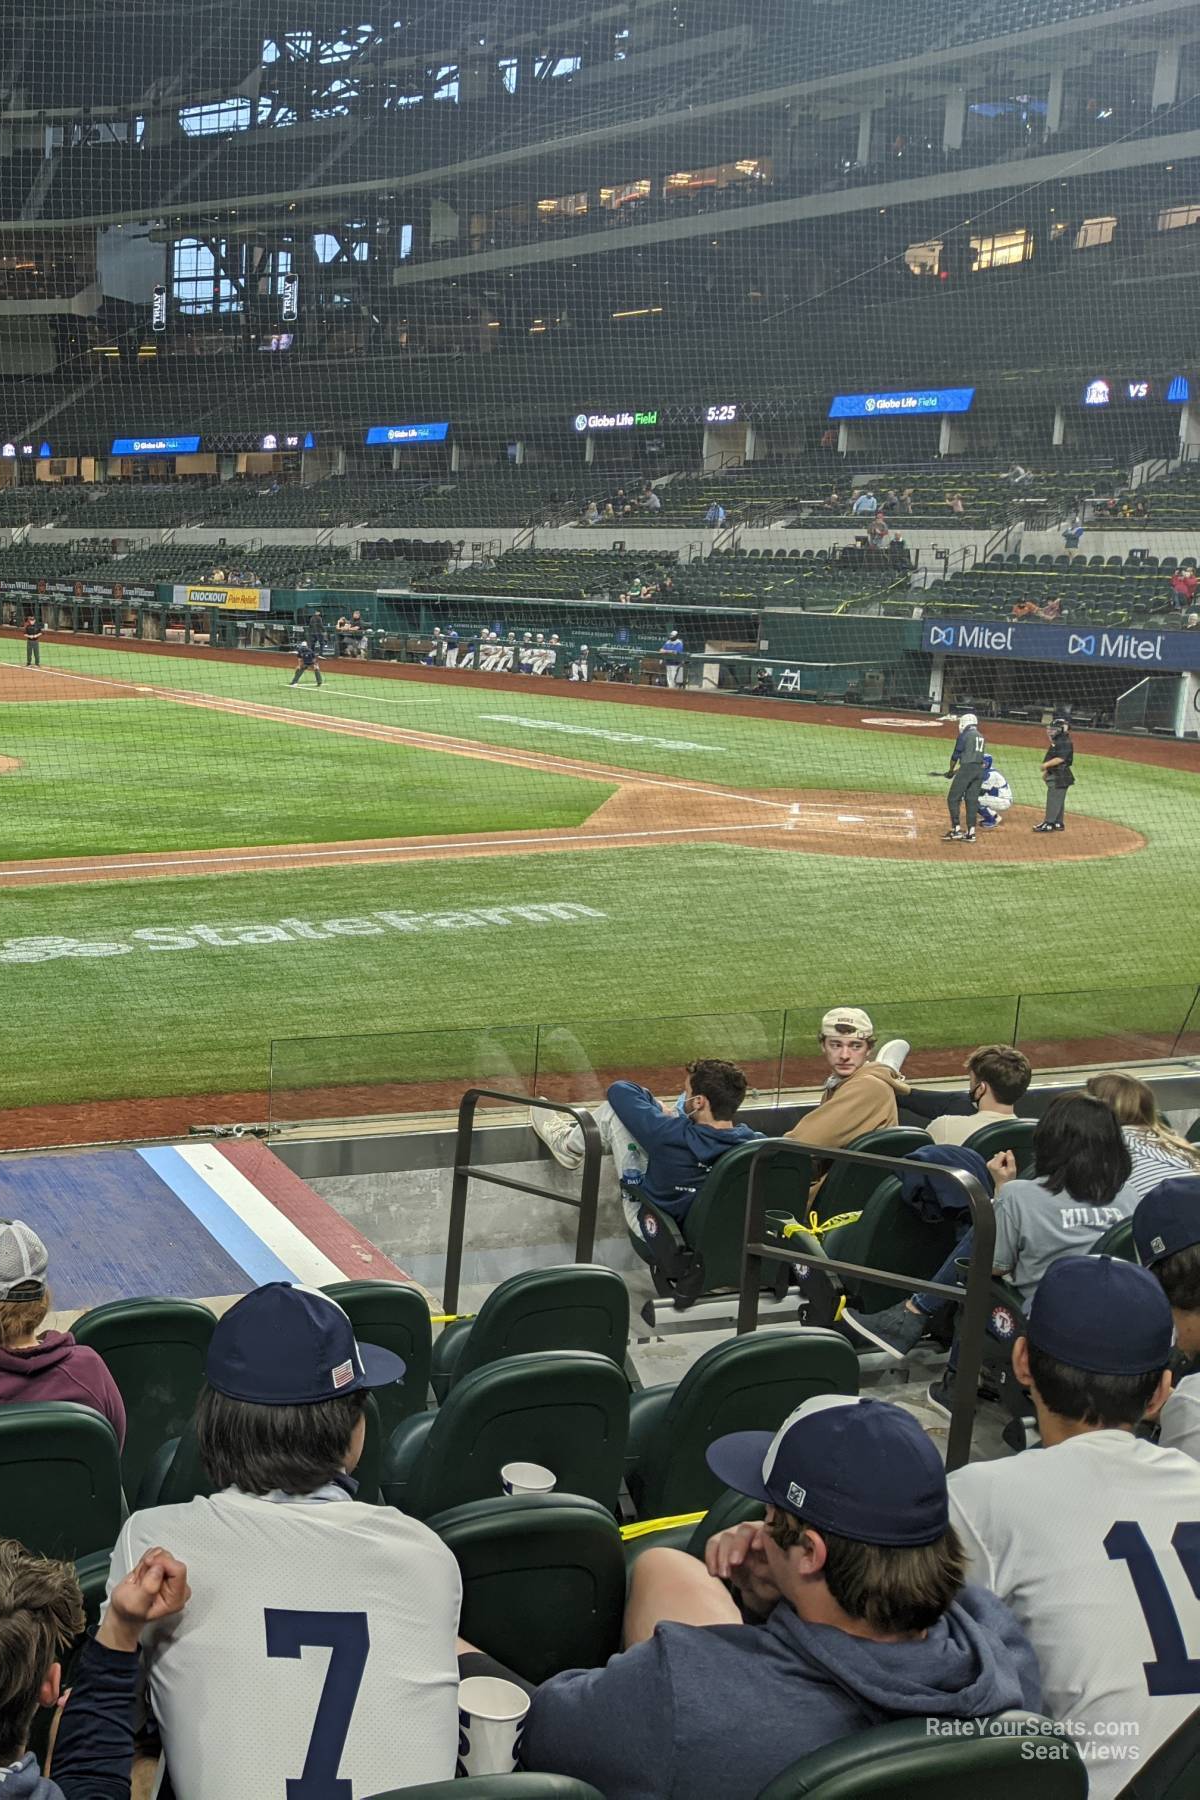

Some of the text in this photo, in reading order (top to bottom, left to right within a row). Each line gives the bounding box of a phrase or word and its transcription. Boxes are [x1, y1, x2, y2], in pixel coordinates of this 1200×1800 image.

[877, 397, 937, 409] Globe Life Field
[588, 411, 657, 428] Globe Life Field
[707, 405, 737, 421] 5:25
[190, 591, 227, 602] KNOCKOUT
[958, 626, 1014, 650] Mitel
[1100, 633, 1163, 660] Mitel
[975, 736, 984, 752] 17
[1060, 1207, 1125, 1229] MILLER
[1000, 1371, 1006, 1384] 3
[264, 1607, 371, 1800] 7
